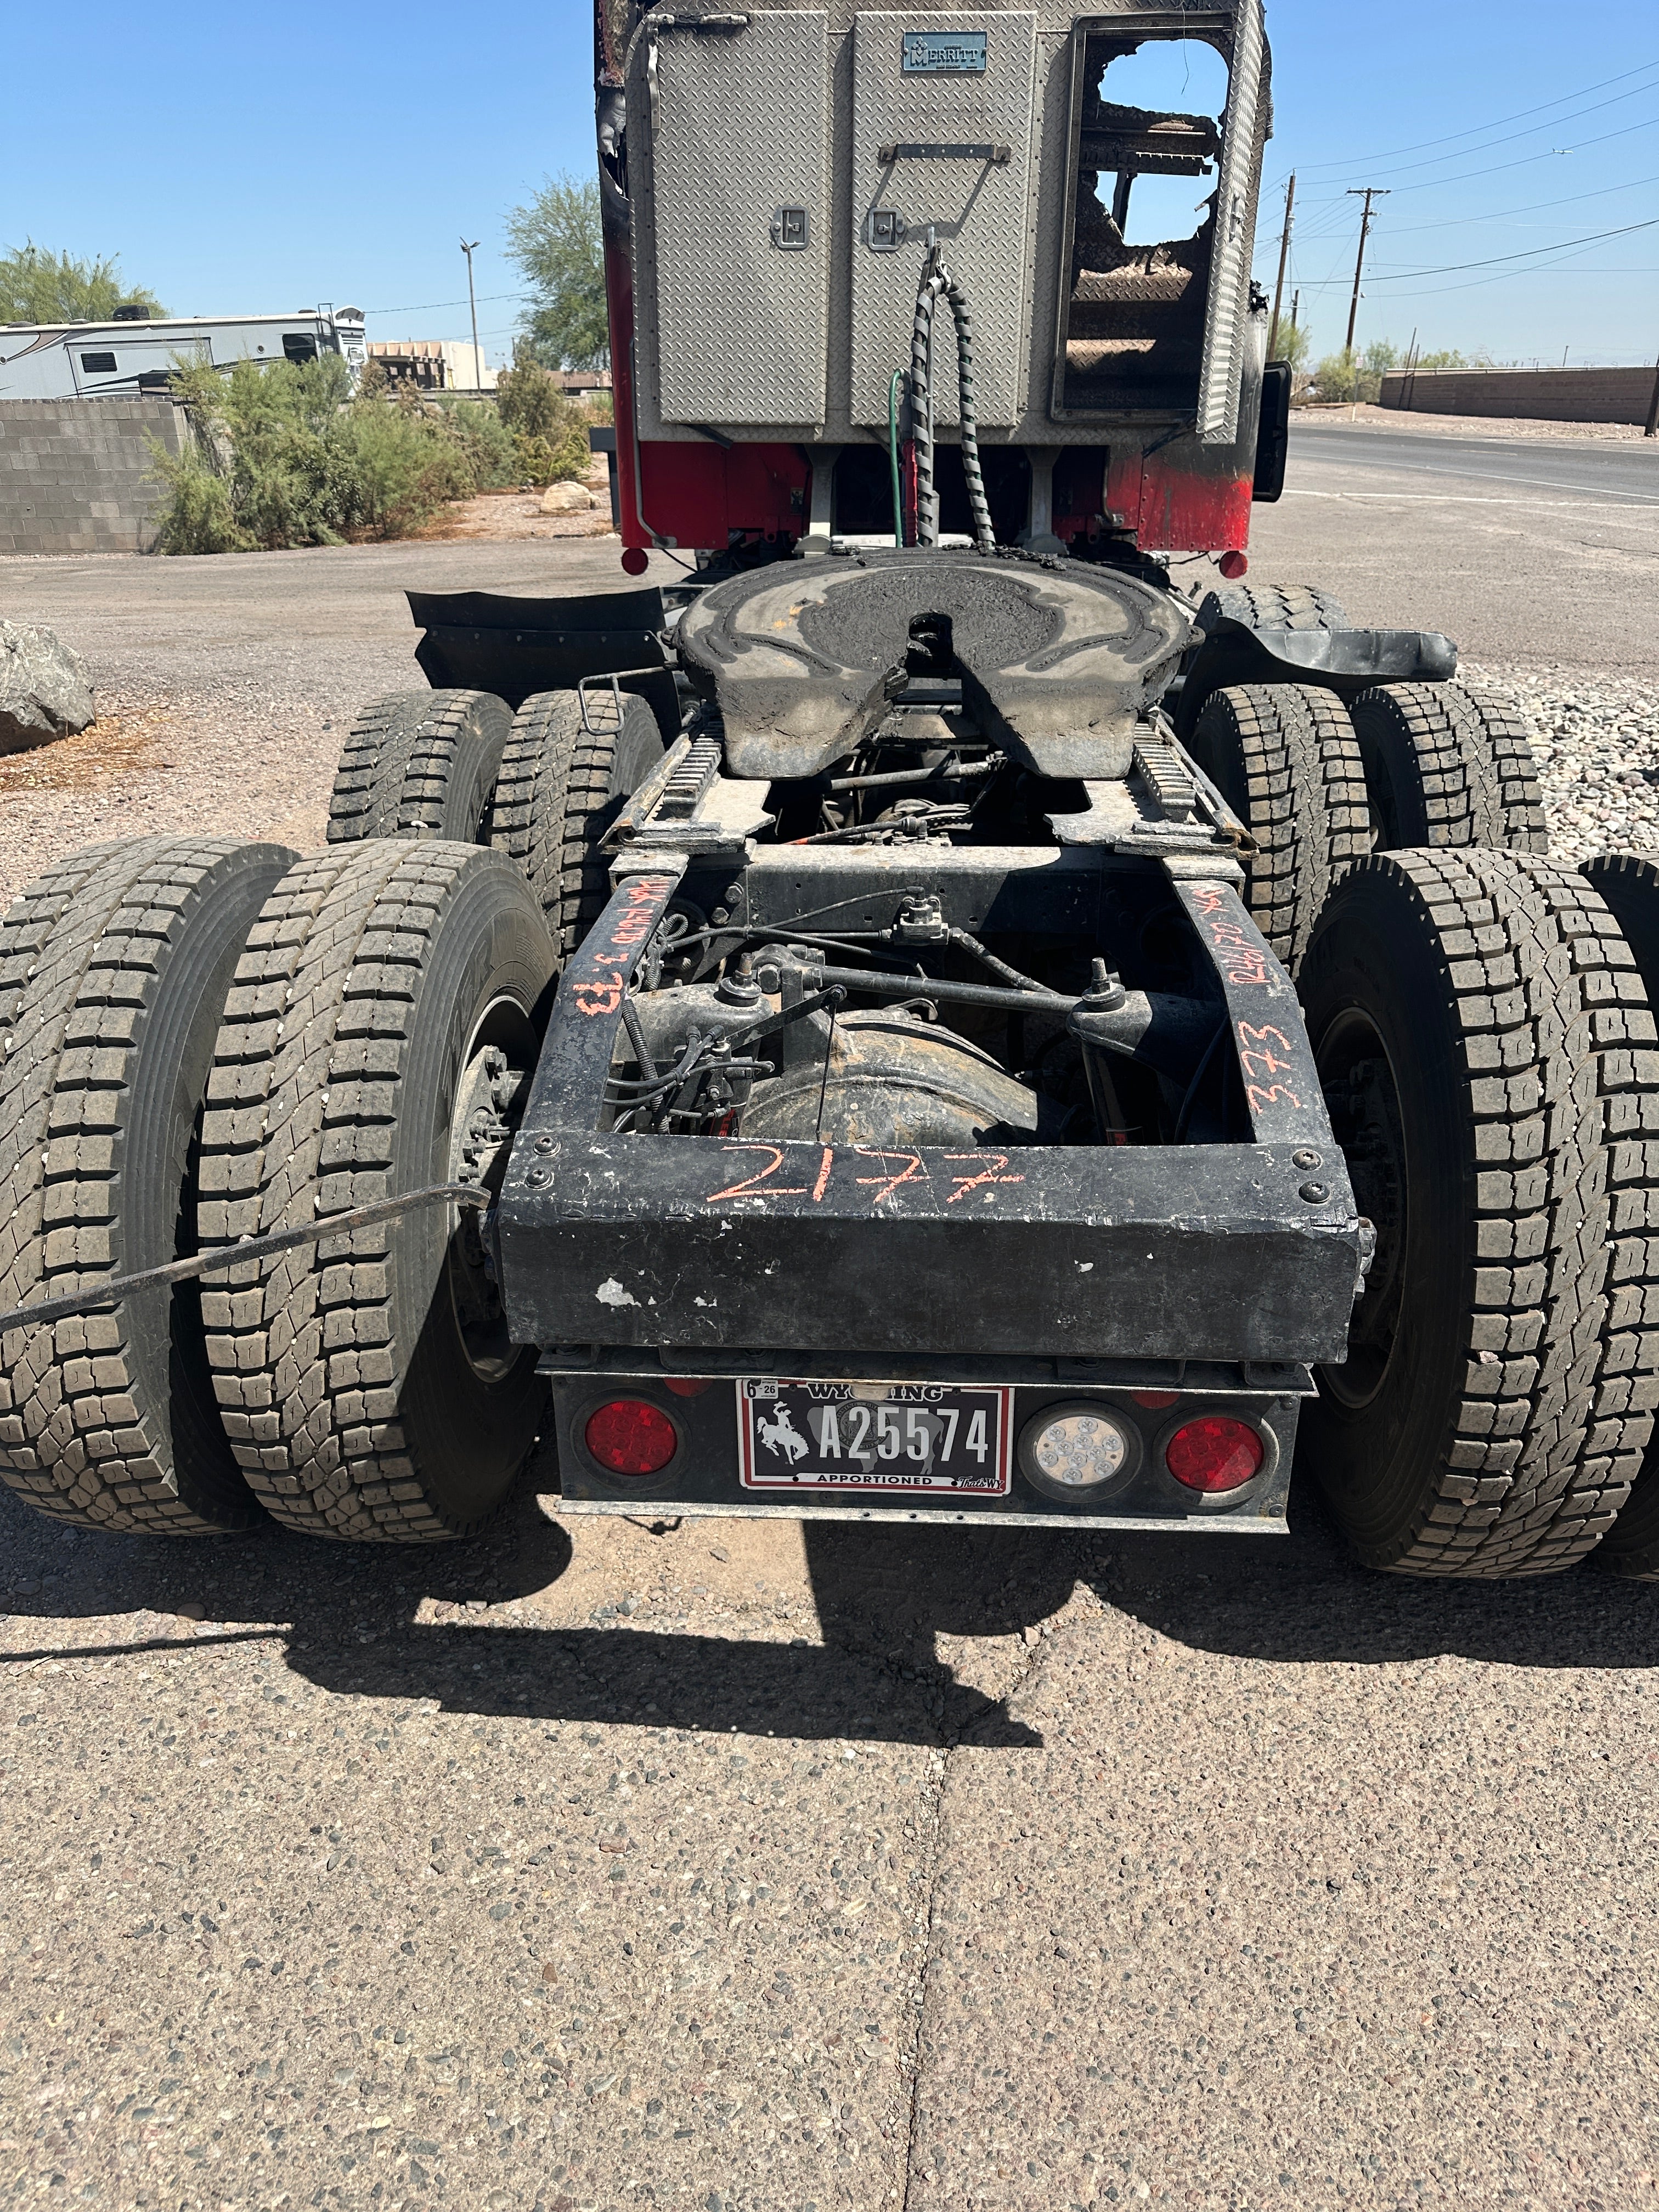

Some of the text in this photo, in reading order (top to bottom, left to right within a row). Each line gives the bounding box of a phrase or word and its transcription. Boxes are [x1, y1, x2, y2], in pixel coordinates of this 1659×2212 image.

[911, 49, 978, 65] MERRITT
[706, 1144, 1025, 1204] 2177
[807, 1383, 943, 1401] WYING
[819, 1405, 989, 1463] A25574
[817, 1474, 932, 1485] APPORTIONED
